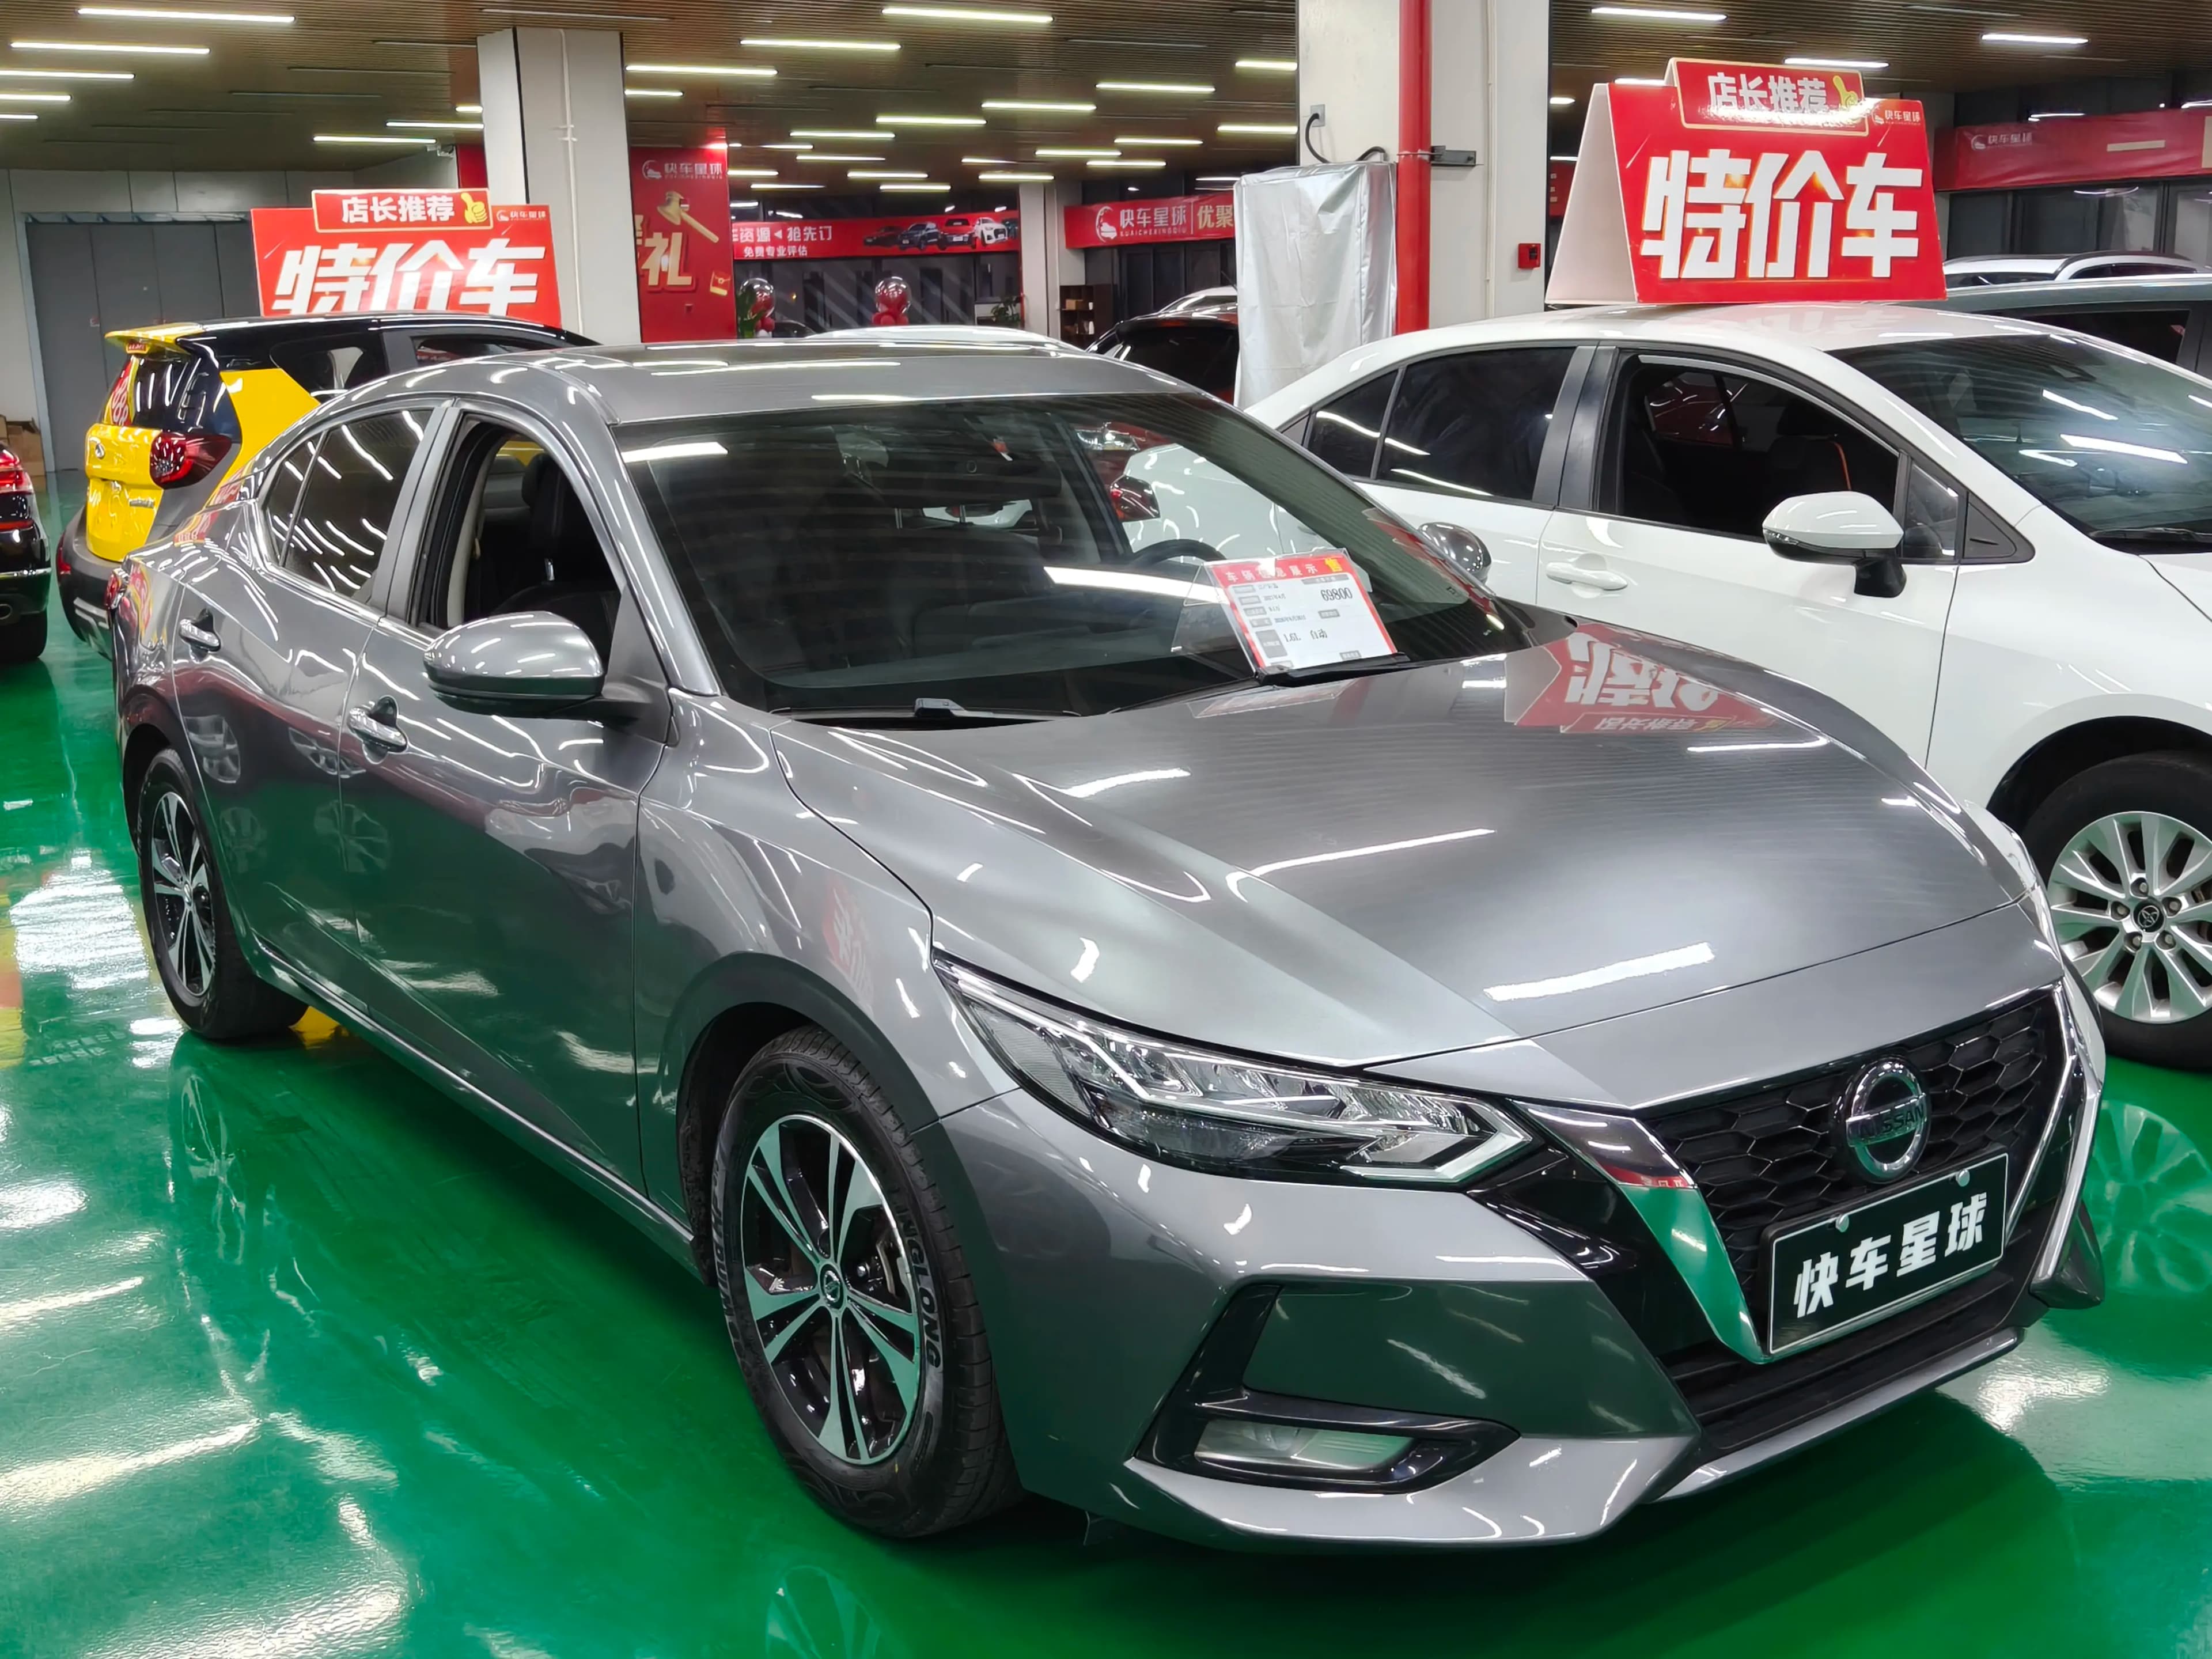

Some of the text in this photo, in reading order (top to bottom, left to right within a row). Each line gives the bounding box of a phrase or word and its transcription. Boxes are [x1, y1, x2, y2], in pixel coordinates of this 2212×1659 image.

[1707, 72, 1827, 114] 店长推荐
[341, 195, 454, 224] 店长推荐
[1119, 204, 1233, 229] 快车星球 优聚
[1640, 149, 1922, 279] 特价车
[787, 226, 832, 242] 抢先订
[272, 237, 546, 316] 特价车
[1320, 586, 1353, 602] 69800
[1793, 1191, 1987, 1319] 快车星球
